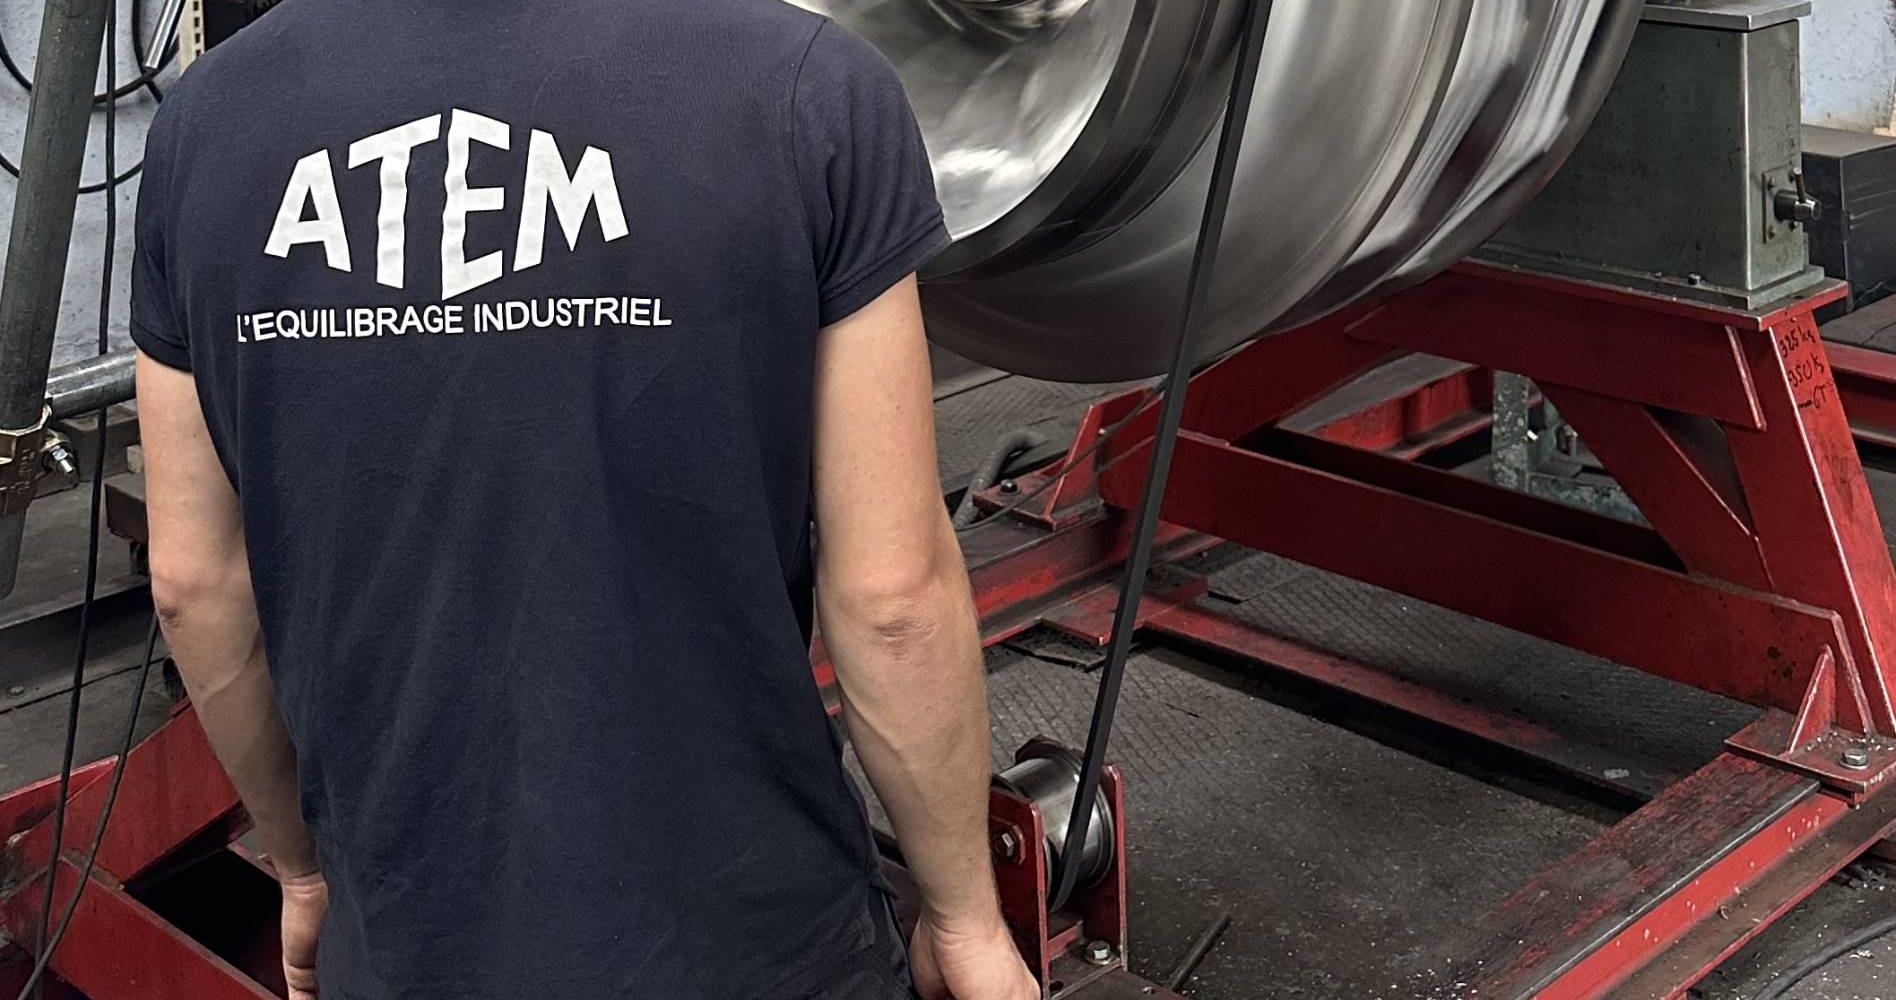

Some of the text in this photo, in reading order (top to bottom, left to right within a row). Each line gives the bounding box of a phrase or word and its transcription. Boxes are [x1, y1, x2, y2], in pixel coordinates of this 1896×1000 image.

[264, 108, 629, 301] ATEM
[237, 297, 672, 342] L'EQUILIBRAGE INDUSTRIEL
